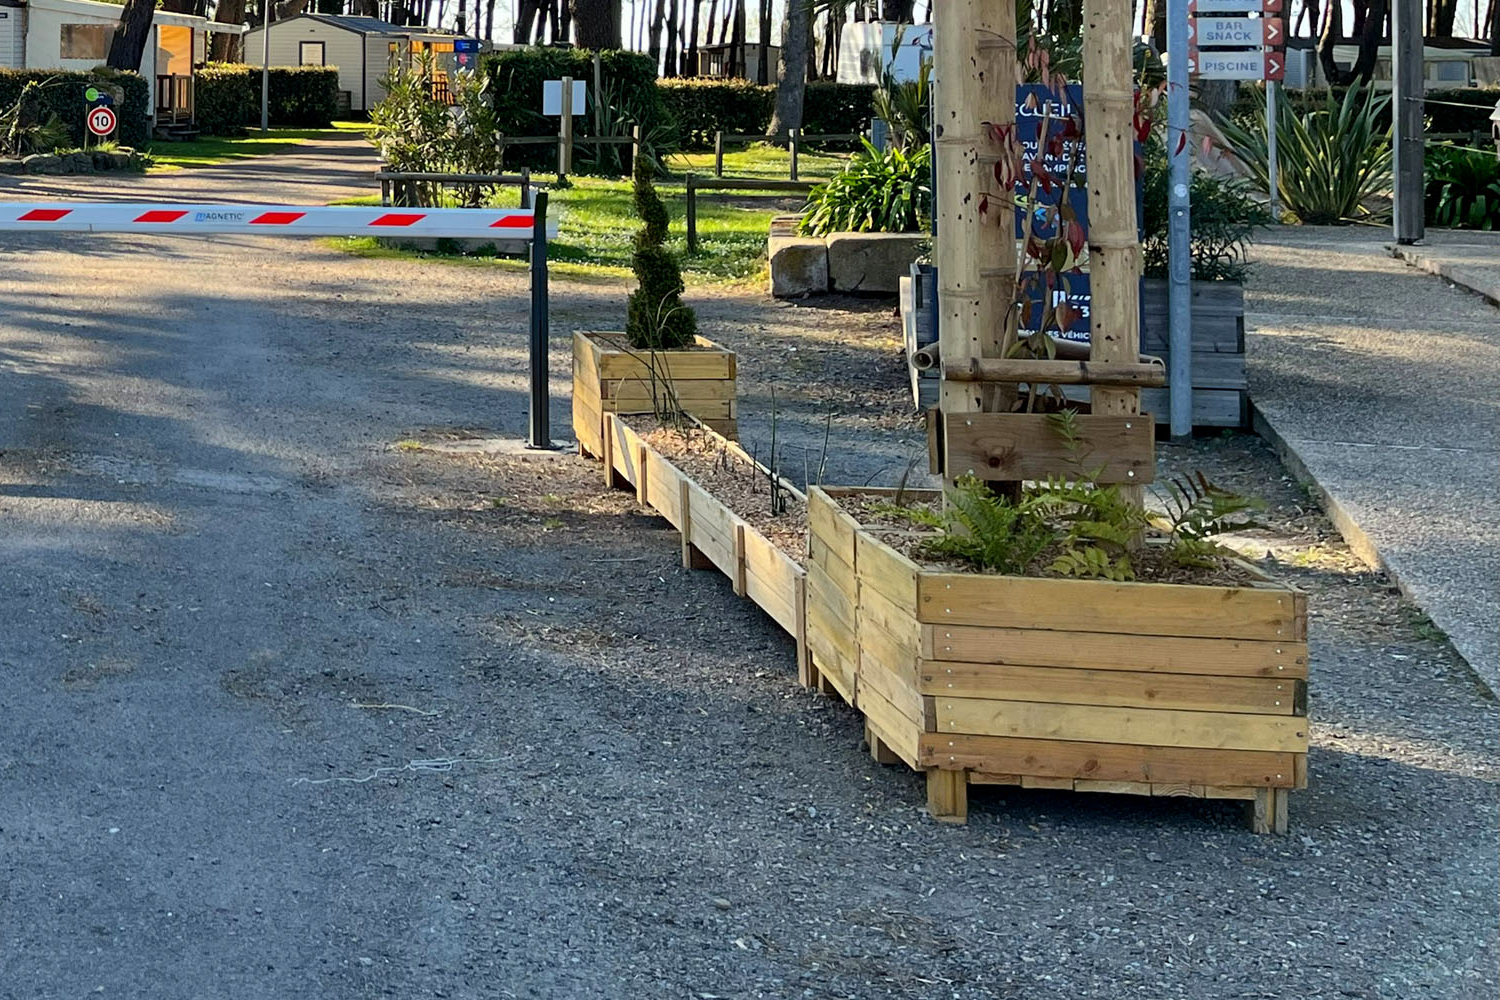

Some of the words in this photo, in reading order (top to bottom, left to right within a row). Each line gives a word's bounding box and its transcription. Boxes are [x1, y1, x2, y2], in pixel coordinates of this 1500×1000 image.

[1215, 21, 1243, 31] BAR
[1206, 31, 1252, 41] SNACK
[1205, 62, 1258, 72] PISCINE
[94, 115, 109, 127] 10
